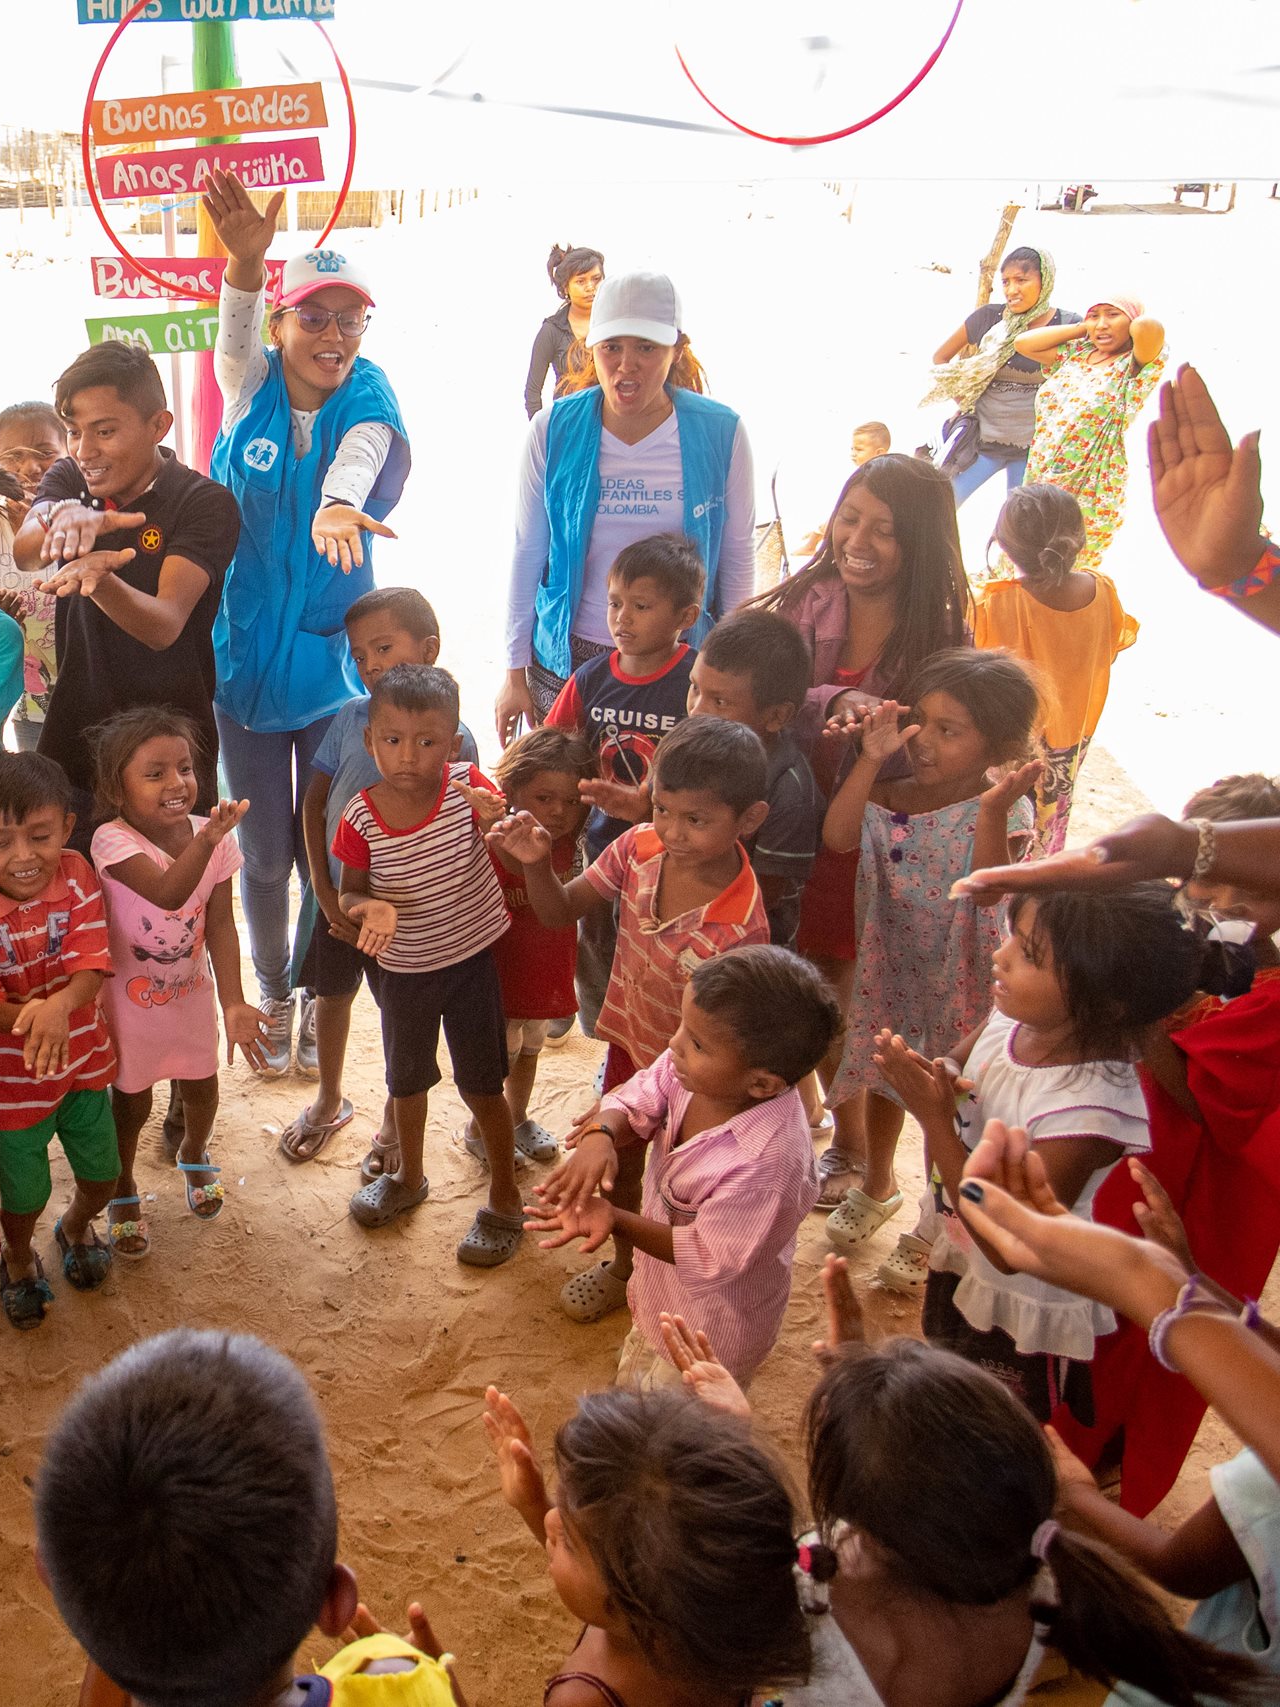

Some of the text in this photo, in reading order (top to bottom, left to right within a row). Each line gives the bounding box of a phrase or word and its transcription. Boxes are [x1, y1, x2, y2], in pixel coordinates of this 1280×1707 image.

[102, 91, 310, 137] Buenas Tardes
[113, 159, 188, 193] Anas
[95, 257, 217, 299] Buenas
[590, 707, 676, 731] CRUISE
